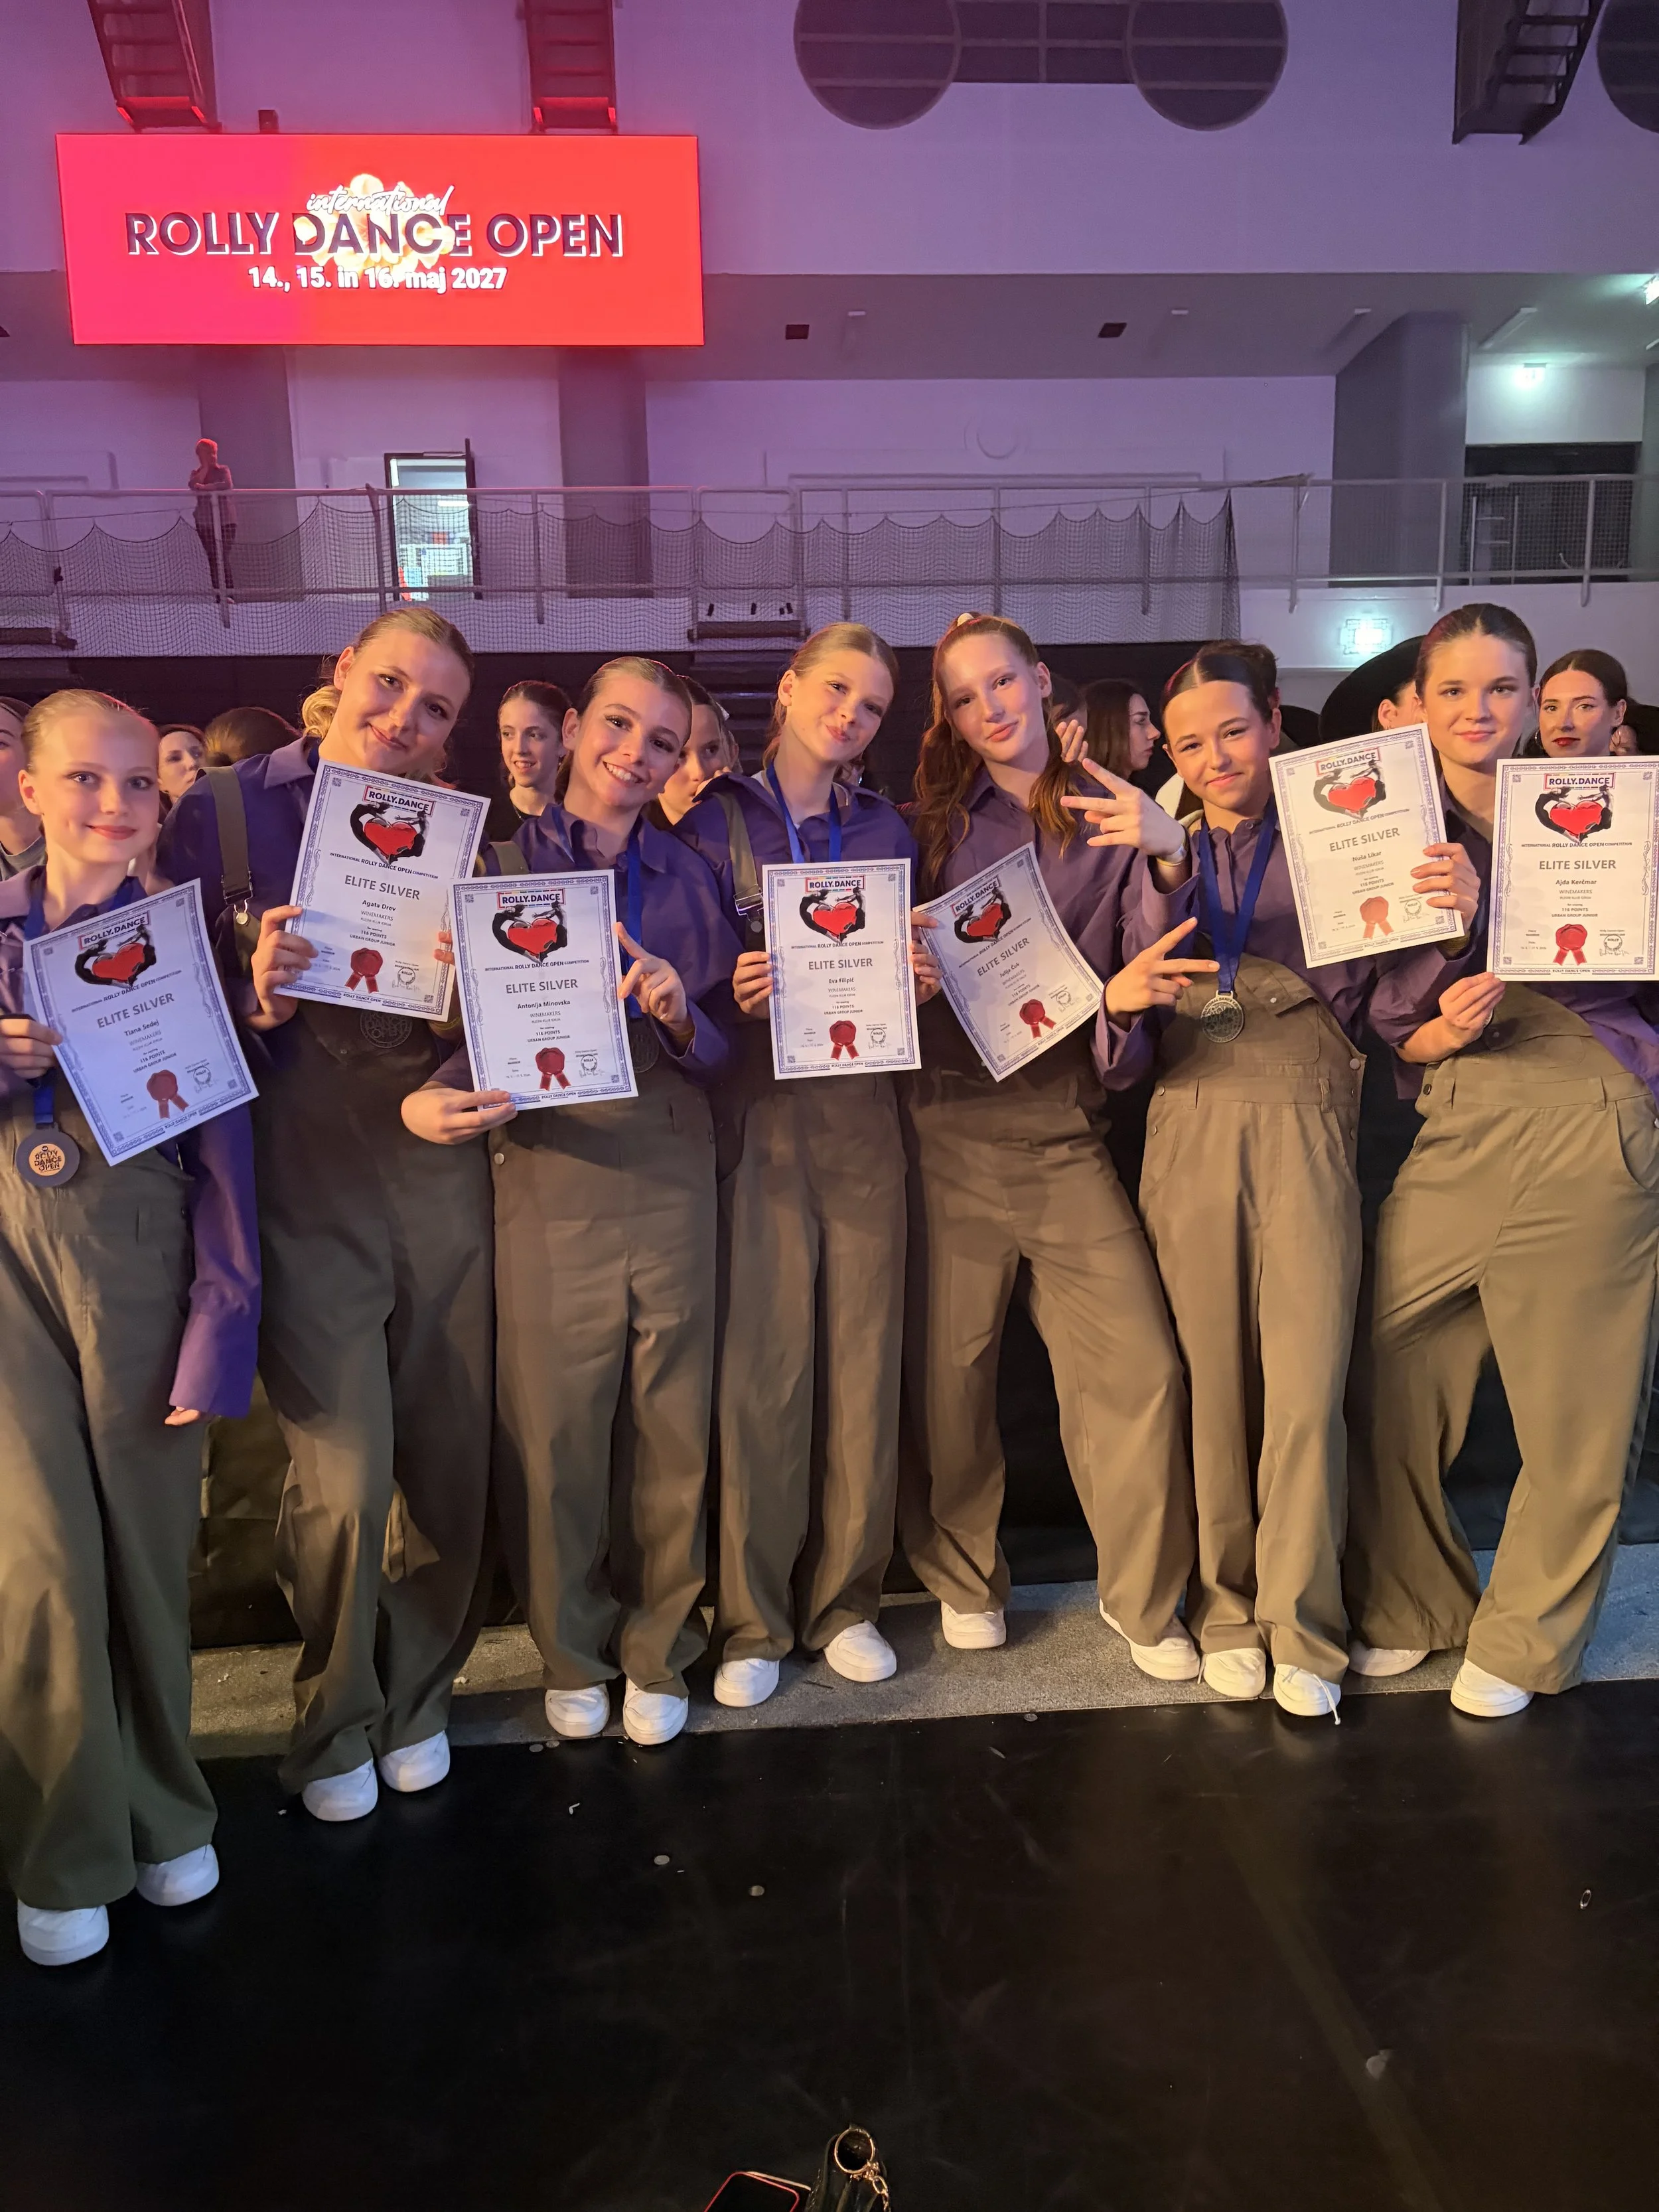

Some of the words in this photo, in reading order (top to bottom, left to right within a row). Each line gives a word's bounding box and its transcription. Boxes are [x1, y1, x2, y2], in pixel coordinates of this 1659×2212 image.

[306, 184, 455, 216] international
[125, 212, 279, 255] ROLLY
[292, 212, 472, 256] DANCE
[486, 213, 622, 257] OPEN
[248, 266, 291, 292] 14.,
[297, 266, 332, 288] 15.
[337, 265, 360, 288] in
[405, 267, 446, 294] maj
[451, 267, 508, 289] 2027
[1321, 753, 1376, 770] ROLLY.DANCE
[368, 791, 429, 811] ROLLY.DANCE
[1329, 838, 1358, 851] ELITE
[1360, 828, 1400, 843] SILVER
[1539, 860, 1570, 869] ELITE
[1573, 860, 1616, 869] SILVER
[344, 875, 376, 890] ELITE
[378, 882, 421, 899] SILVER
[809, 879, 861, 888] ROLLY.DANCE
[502, 893, 560, 903] ROLLY.DANCE
[955, 881, 997, 911] ROLLY.DANCE
[84, 917, 145, 944] ROLLY.DANCE
[808, 960, 835, 970] ELITE
[837, 958, 873, 968] SILVER
[977, 958, 999, 976] ELITE
[999, 937, 1029, 960] SILVER
[141, 979, 155, 988] OPEN
[506, 982, 536, 994] ELITE
[538, 978, 578, 991] SILVER
[96, 1007, 129, 1029] ELITE
[132, 991, 174, 1016] SILVER
[34, 1155, 61, 1166] DANCE
[38, 1161, 60, 1171] OPEN
